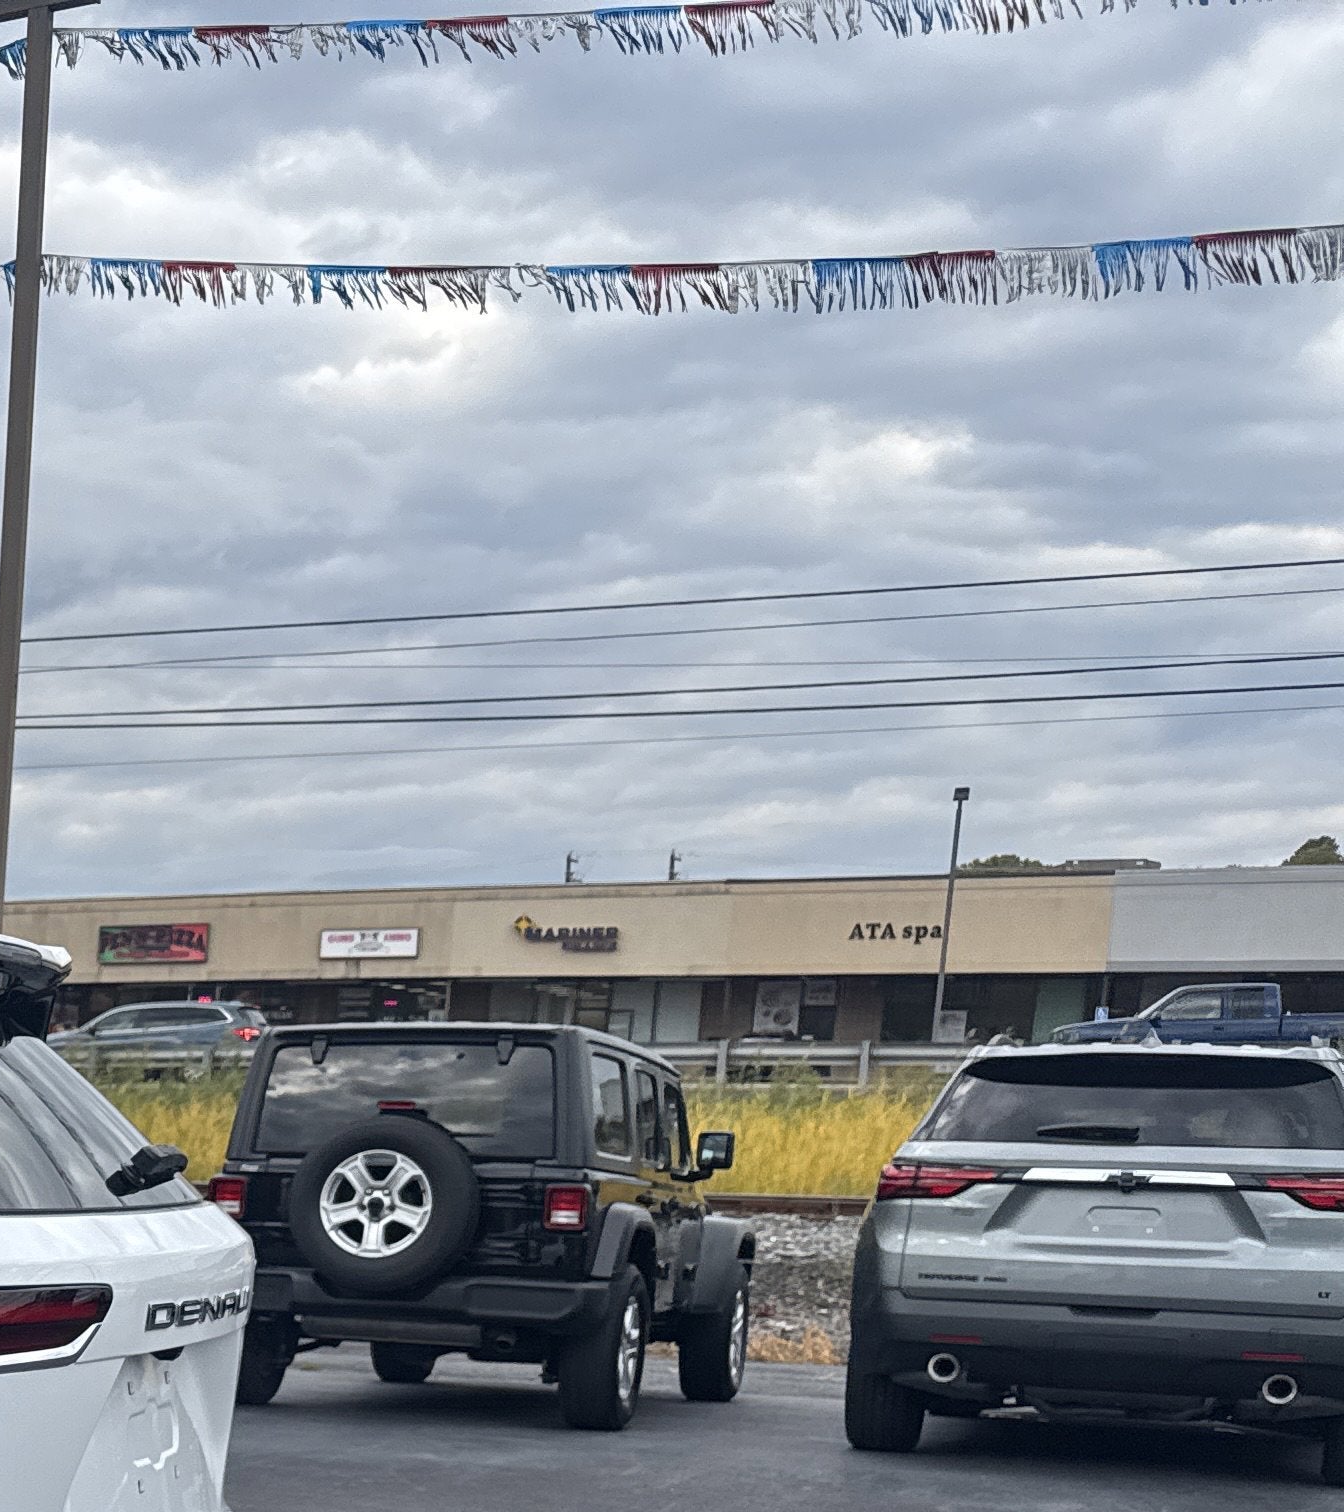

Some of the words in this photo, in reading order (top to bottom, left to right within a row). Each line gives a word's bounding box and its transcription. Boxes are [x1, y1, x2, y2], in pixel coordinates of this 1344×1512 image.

[525, 927, 618, 941] MARINER
[848, 923, 896, 940] ATA
[902, 925, 942, 944] spa
[144, 1287, 250, 1331] DENALI
